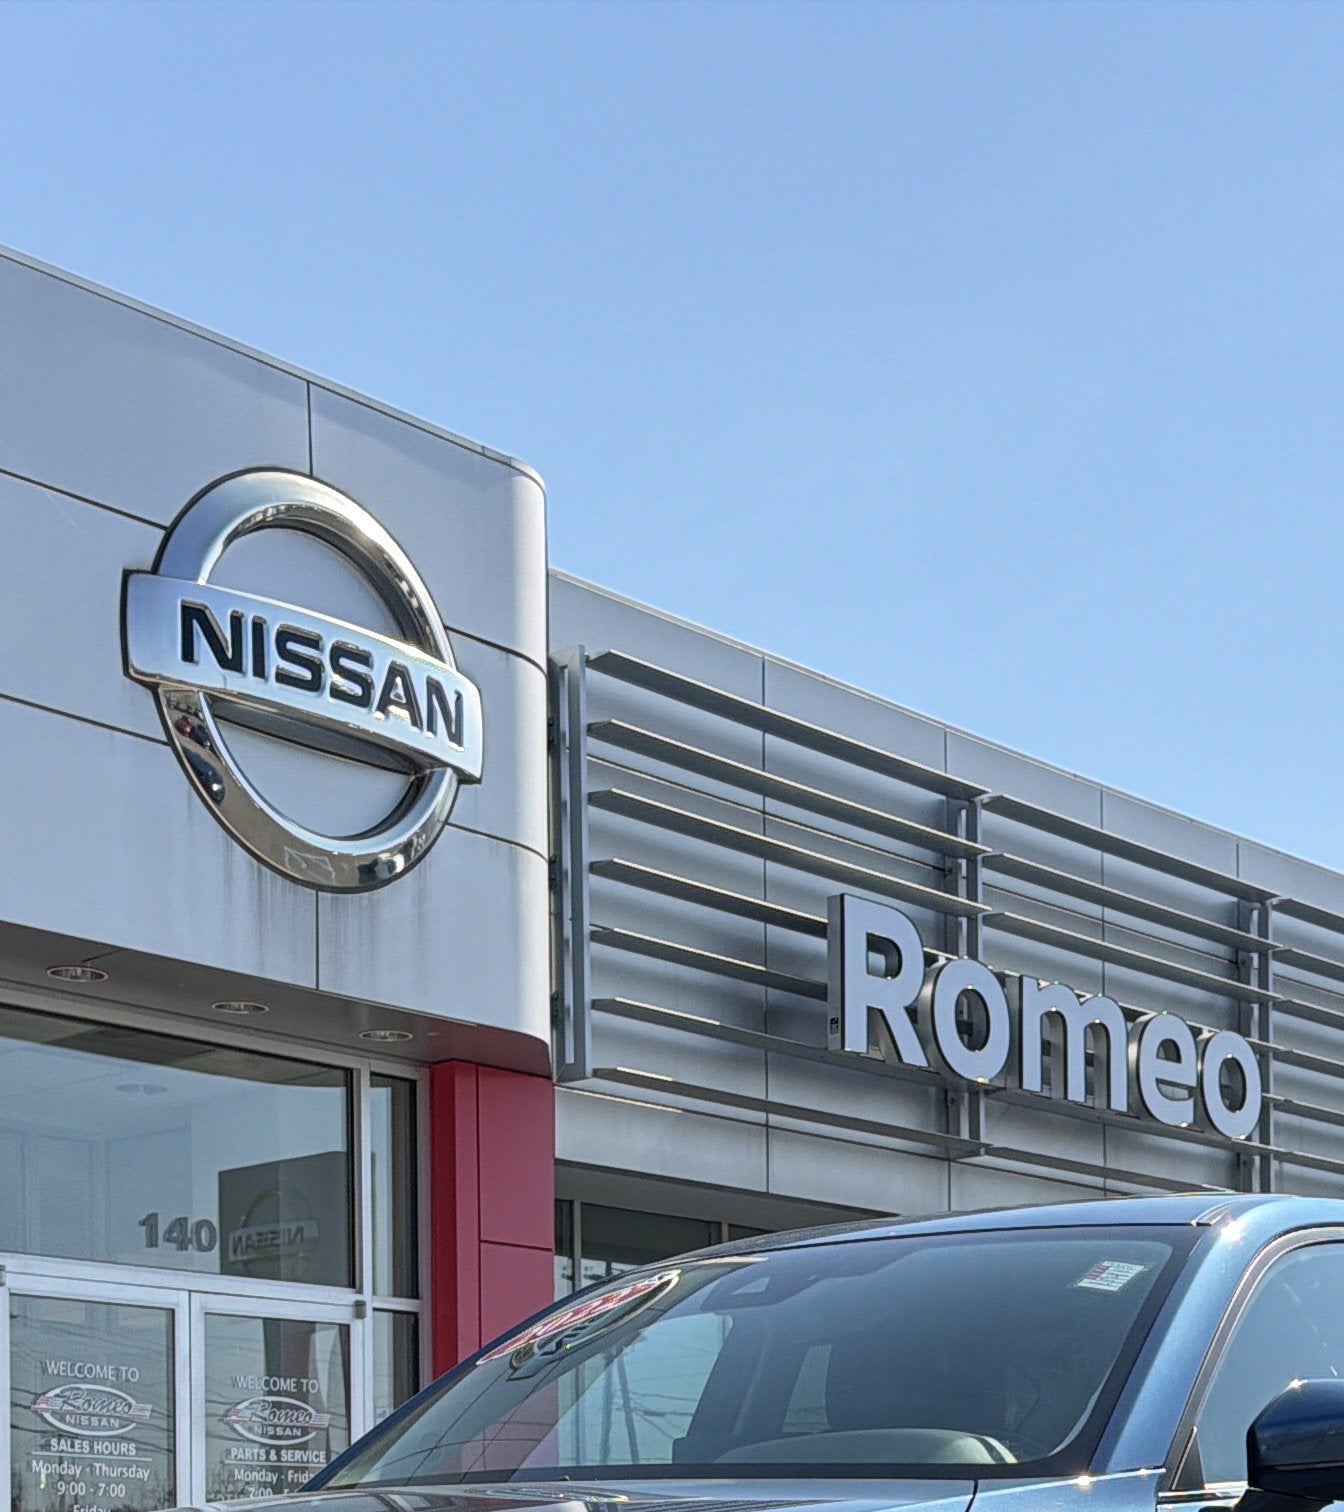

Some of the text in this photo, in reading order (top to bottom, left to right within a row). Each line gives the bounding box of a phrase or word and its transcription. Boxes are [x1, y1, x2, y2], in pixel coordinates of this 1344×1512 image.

[180, 598, 465, 752] NISSAN
[834, 893, 1263, 1140] Romeo
[138, 1212, 218, 1253] 140
[45, 1360, 140, 1382] WELCOME TO
[236, 1375, 319, 1394] WELCOME TO
[56, 1386, 133, 1415] Romeo
[65, 1414, 120, 1428] NISSAN
[248, 1398, 313, 1425] Romeo
[254, 1425, 302, 1437] NISSAN
[50, 1438, 137, 1456] SALES HOURS
[230, 1447, 327, 1463] PARTS & SERVICE
[31, 1459, 82, 1479] Monday
[92, 1462, 151, 1482] Thursday
[234, 1468, 279, 1486] Monday
[57, 1481, 87, 1496] 9:00
[98, 1482, 126, 1498] 7:00
